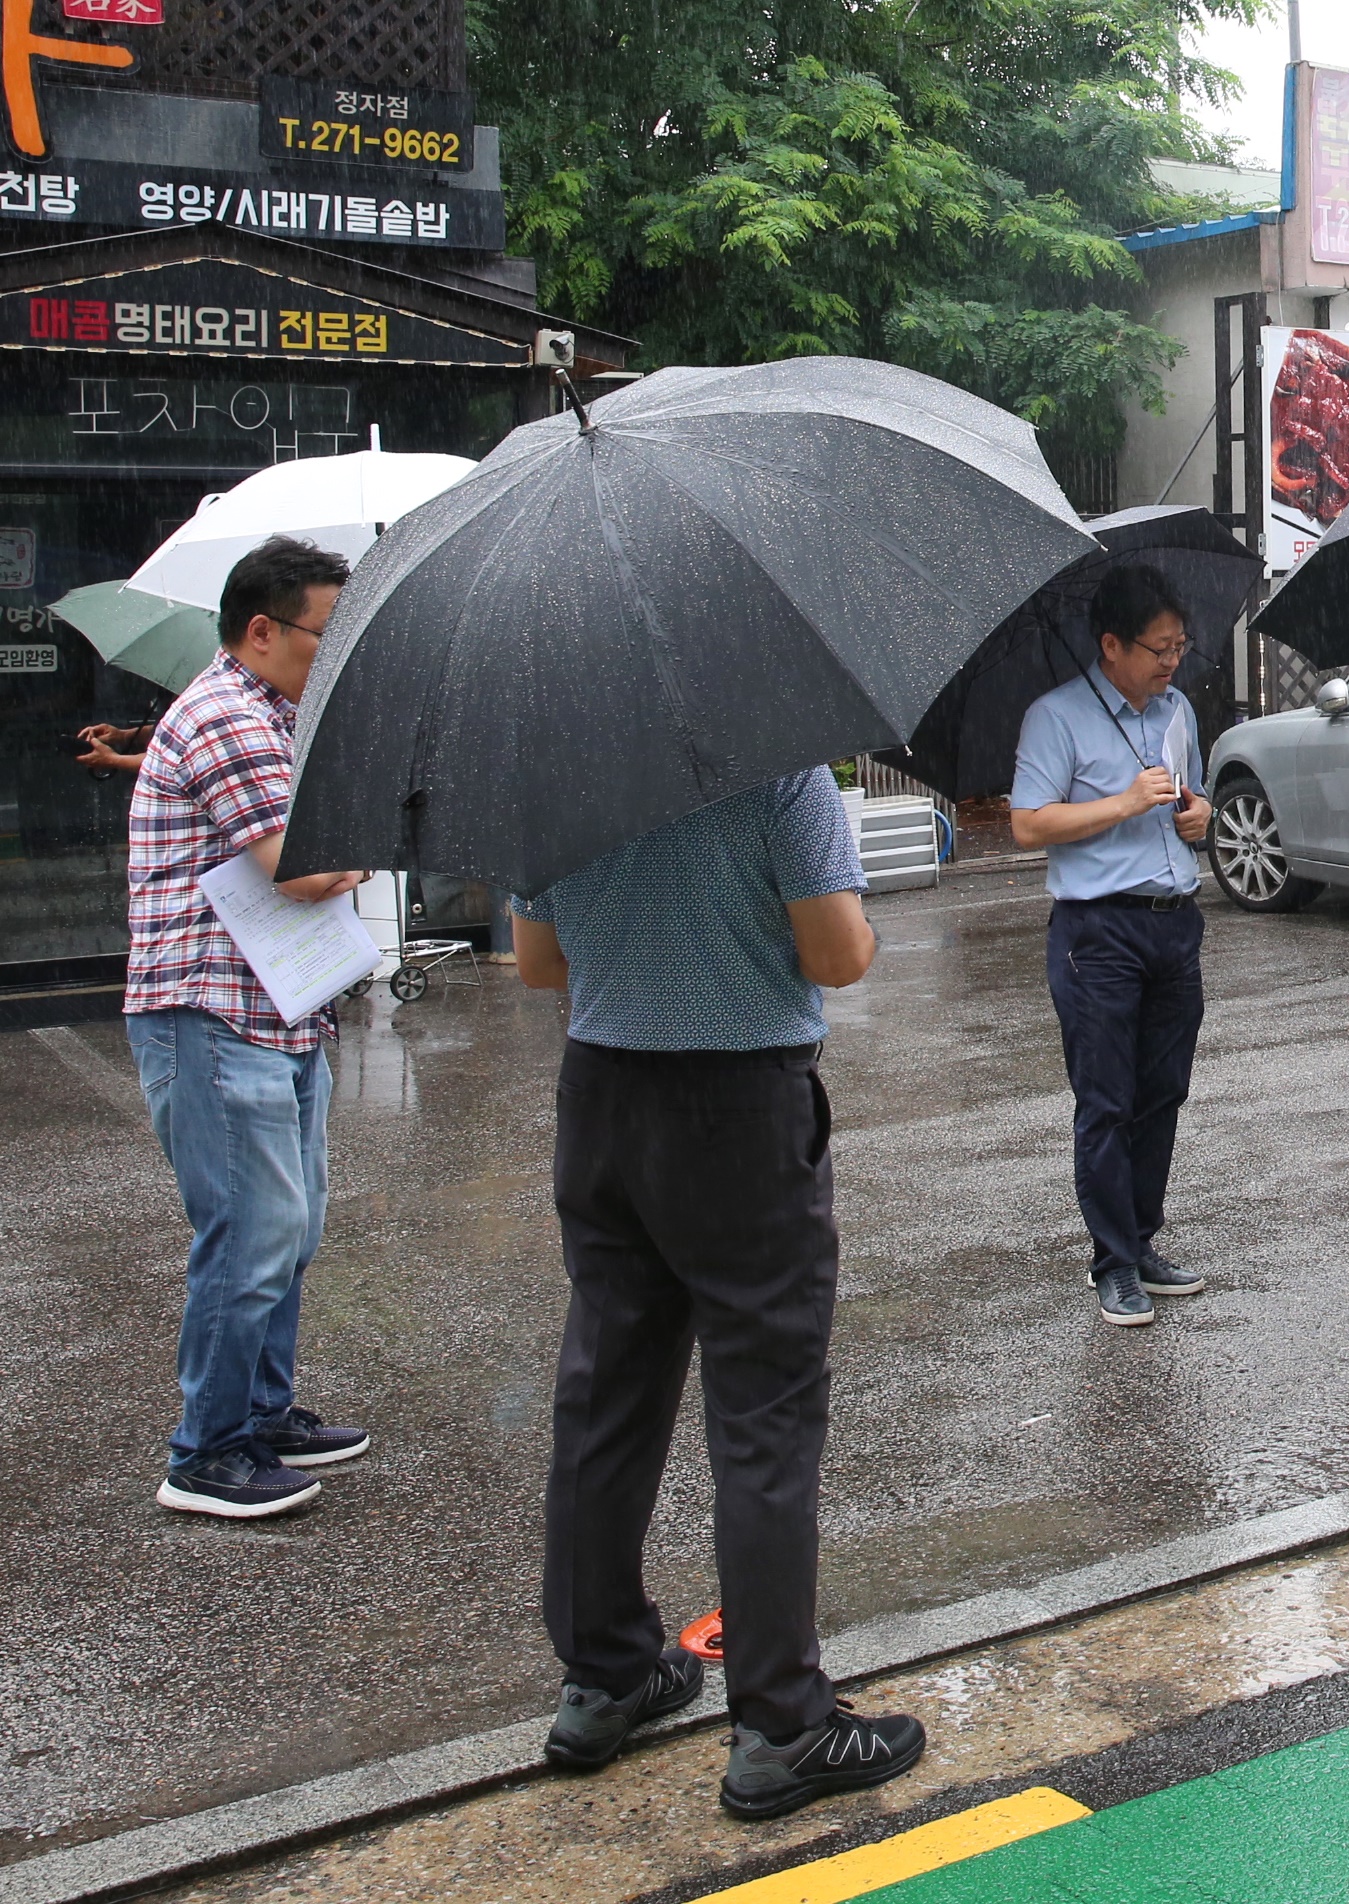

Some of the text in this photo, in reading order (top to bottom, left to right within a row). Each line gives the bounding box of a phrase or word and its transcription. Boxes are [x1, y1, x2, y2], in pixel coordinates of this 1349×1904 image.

[335, 90, 409, 119] 정자점
[278, 117, 460, 163] T.271-9662
[279, 309, 388, 352] 전문점
[0, 604, 62, 633] 명가
